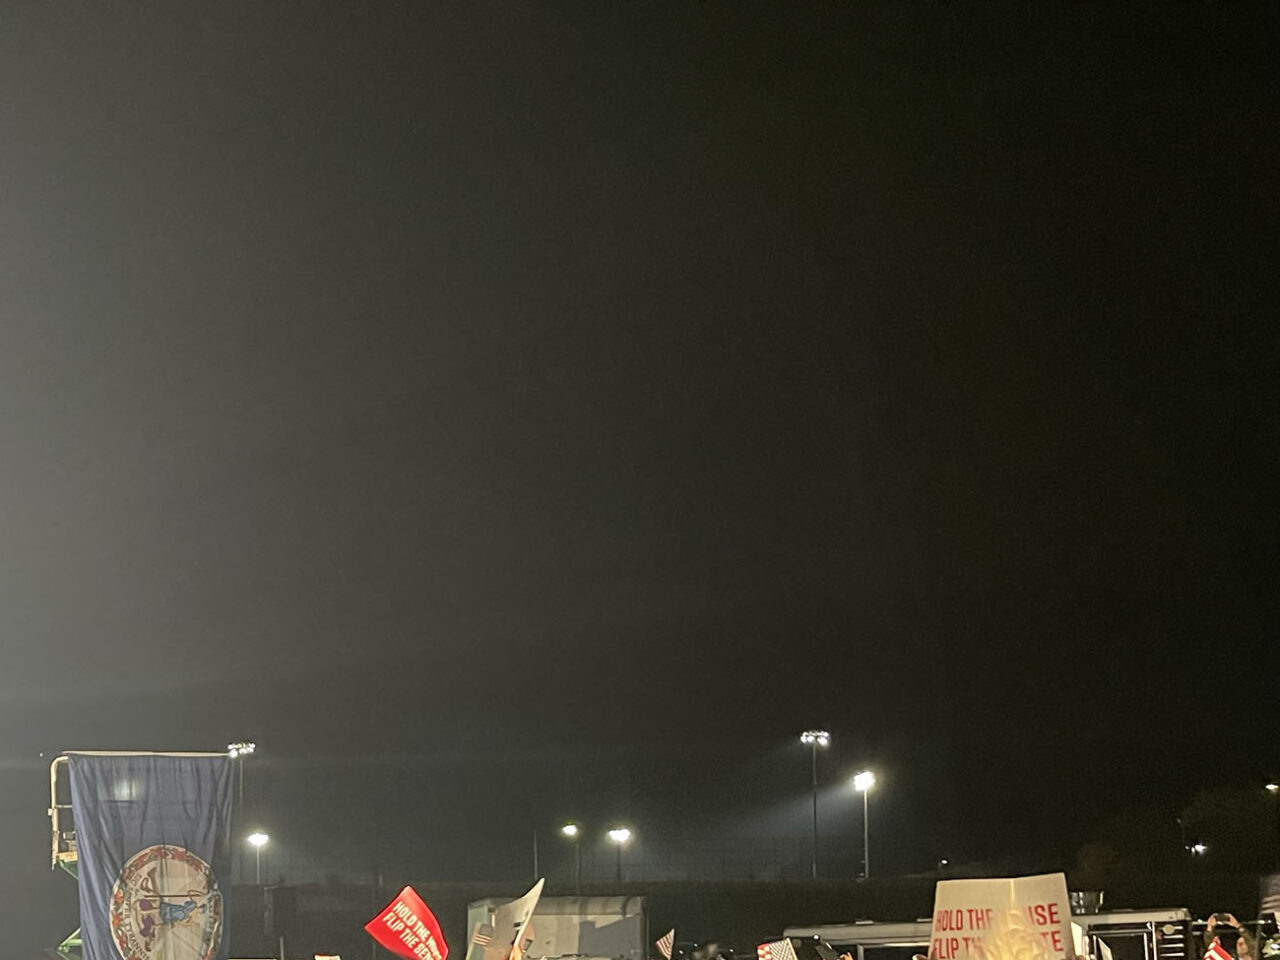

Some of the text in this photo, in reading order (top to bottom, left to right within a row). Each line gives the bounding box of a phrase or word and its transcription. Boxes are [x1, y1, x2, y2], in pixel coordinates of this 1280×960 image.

[382, 911, 405, 932] FLIP
[400, 928, 420, 949] THE
[393, 901, 417, 926] HOLD
[412, 921, 431, 942] THE
